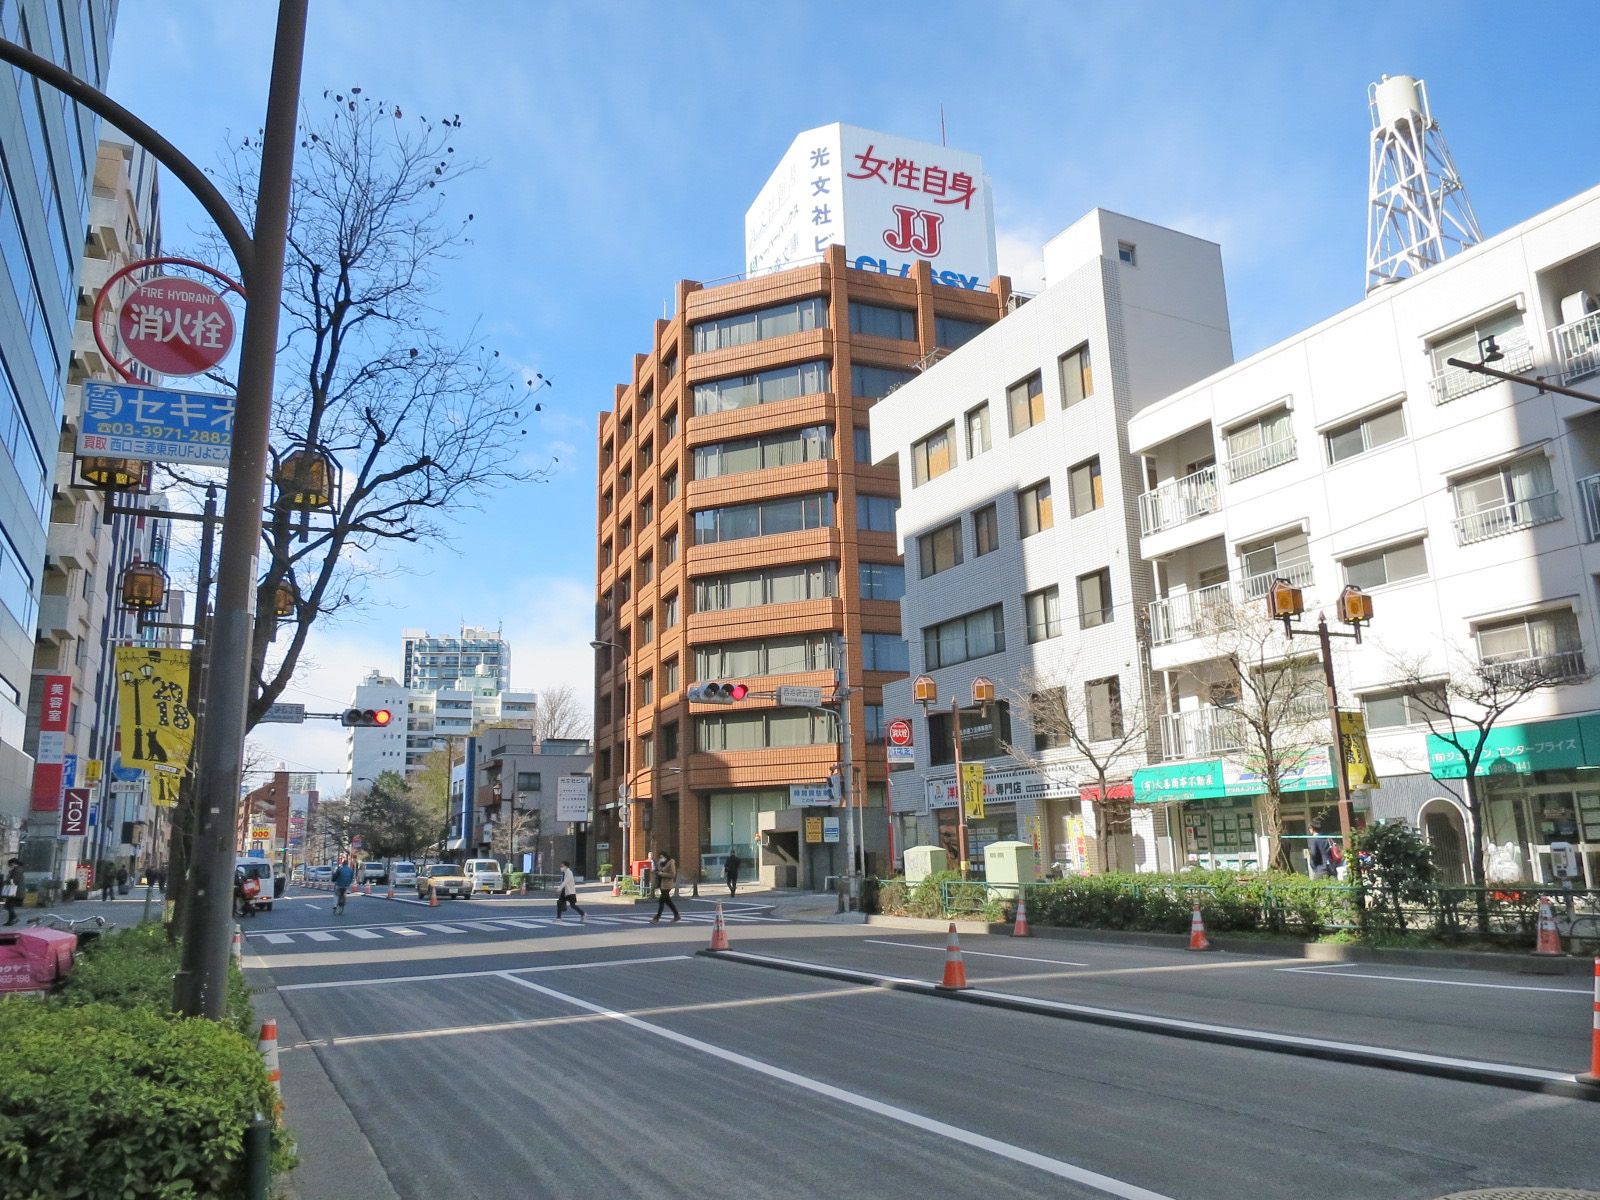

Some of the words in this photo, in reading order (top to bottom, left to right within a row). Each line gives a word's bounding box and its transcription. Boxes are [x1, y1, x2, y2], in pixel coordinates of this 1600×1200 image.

[846, 145, 977, 210] 女性自身
[809, 147, 835, 253] 光文社ビ
[882, 204, 945, 258] JJ
[855, 255, 980, 291] CSY
[140, 287, 164, 299] FIRE
[167, 289, 217, 305] HYDRANT
[128, 303, 226, 349] 消火栓
[84, 435, 107, 450] 買取
[112, 422, 231, 445] 03-3971-2882
[47, 683, 64, 722] 美容室
[783, 687, 820, 698] 西池袋五丁目
[892, 729, 908, 738] 消火栓
[66, 791, 83, 832] AEON
